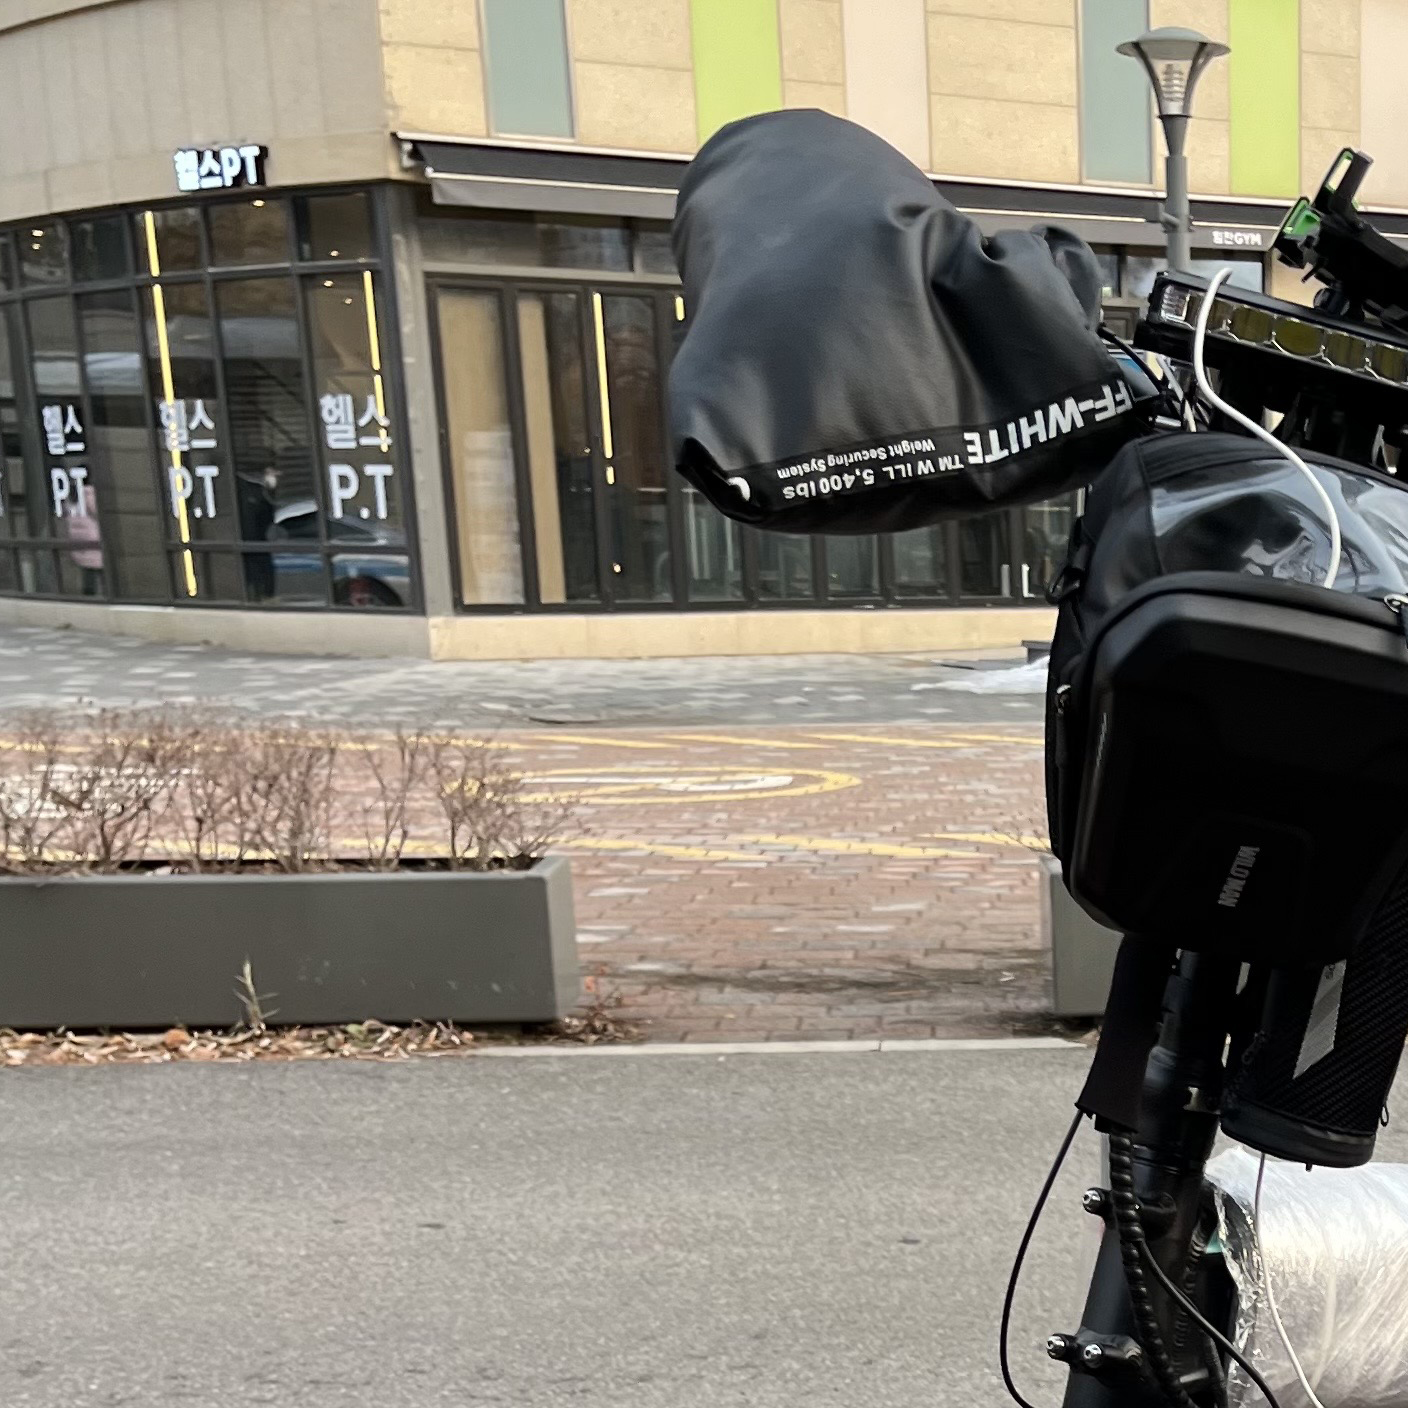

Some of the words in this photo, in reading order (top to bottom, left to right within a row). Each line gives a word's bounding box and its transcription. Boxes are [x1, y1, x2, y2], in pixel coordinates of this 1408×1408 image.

[173, 145, 264, 191] 헬스PT
[42, 405, 85, 455] 헬스
[159, 399, 217, 451] 헬스
[318, 394, 393, 449] 헬스
[964, 379, 1134, 464] FF-WHITE
[776, 457, 827, 479] System
[827, 447, 887, 467] Securing
[888, 438, 936, 458] Weight
[168, 465, 220, 518] P.T
[328, 464, 394, 519] P.T
